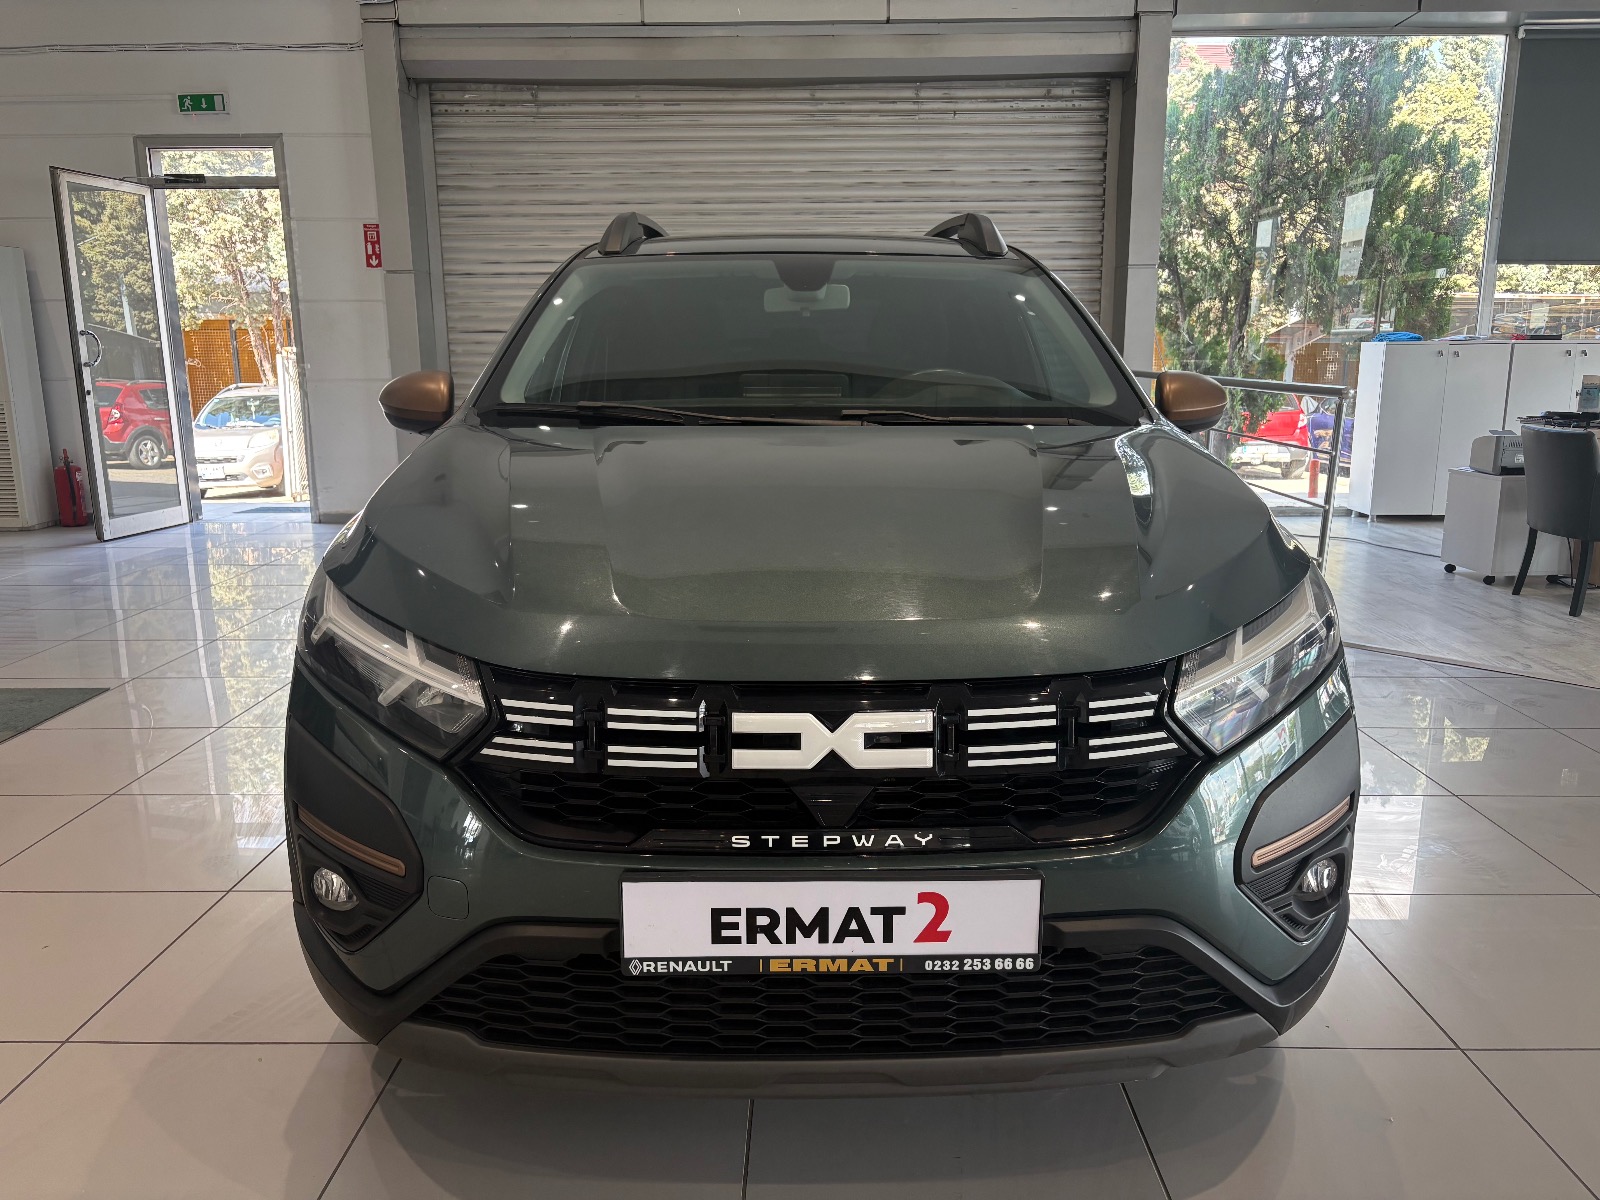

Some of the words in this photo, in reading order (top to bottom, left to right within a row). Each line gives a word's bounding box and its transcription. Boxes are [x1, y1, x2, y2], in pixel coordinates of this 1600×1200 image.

[731, 833, 933, 848] STEPWAY
[710, 906, 907, 945] ERMAT
[913, 891, 953, 943] 2
[643, 960, 733, 973] RENAULT
[769, 958, 895, 972] ERMAT
[925, 960, 960, 971] 0232
[964, 958, 991, 970] 253
[995, 958, 1013, 970] 66
[1016, 958, 1035, 970] 66
